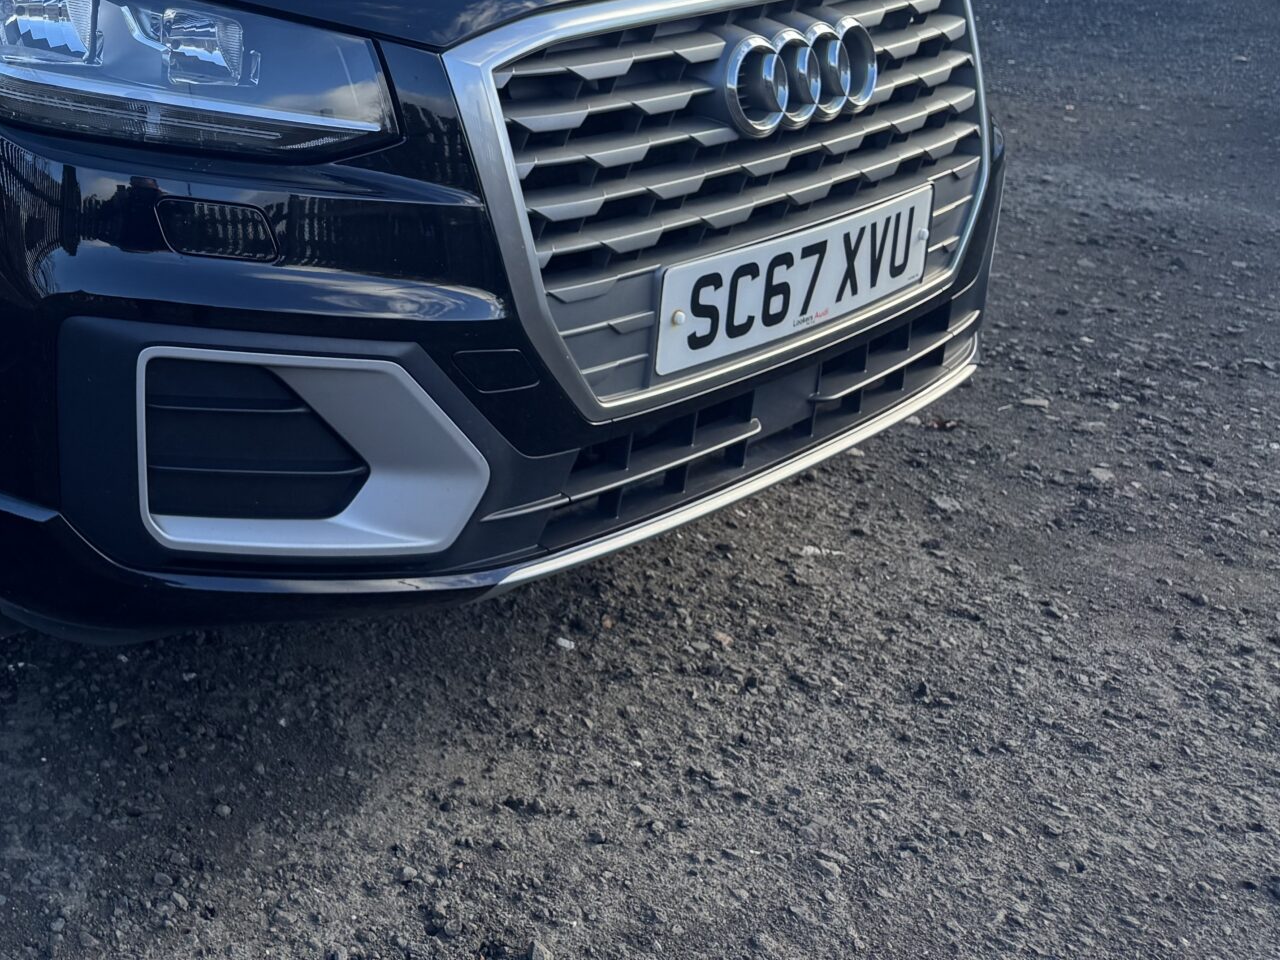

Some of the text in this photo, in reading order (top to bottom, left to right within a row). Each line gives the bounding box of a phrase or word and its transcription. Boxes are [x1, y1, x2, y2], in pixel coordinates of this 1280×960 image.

[687, 206, 916, 351] SC67 XVU
[814, 307, 830, 319] Audi
